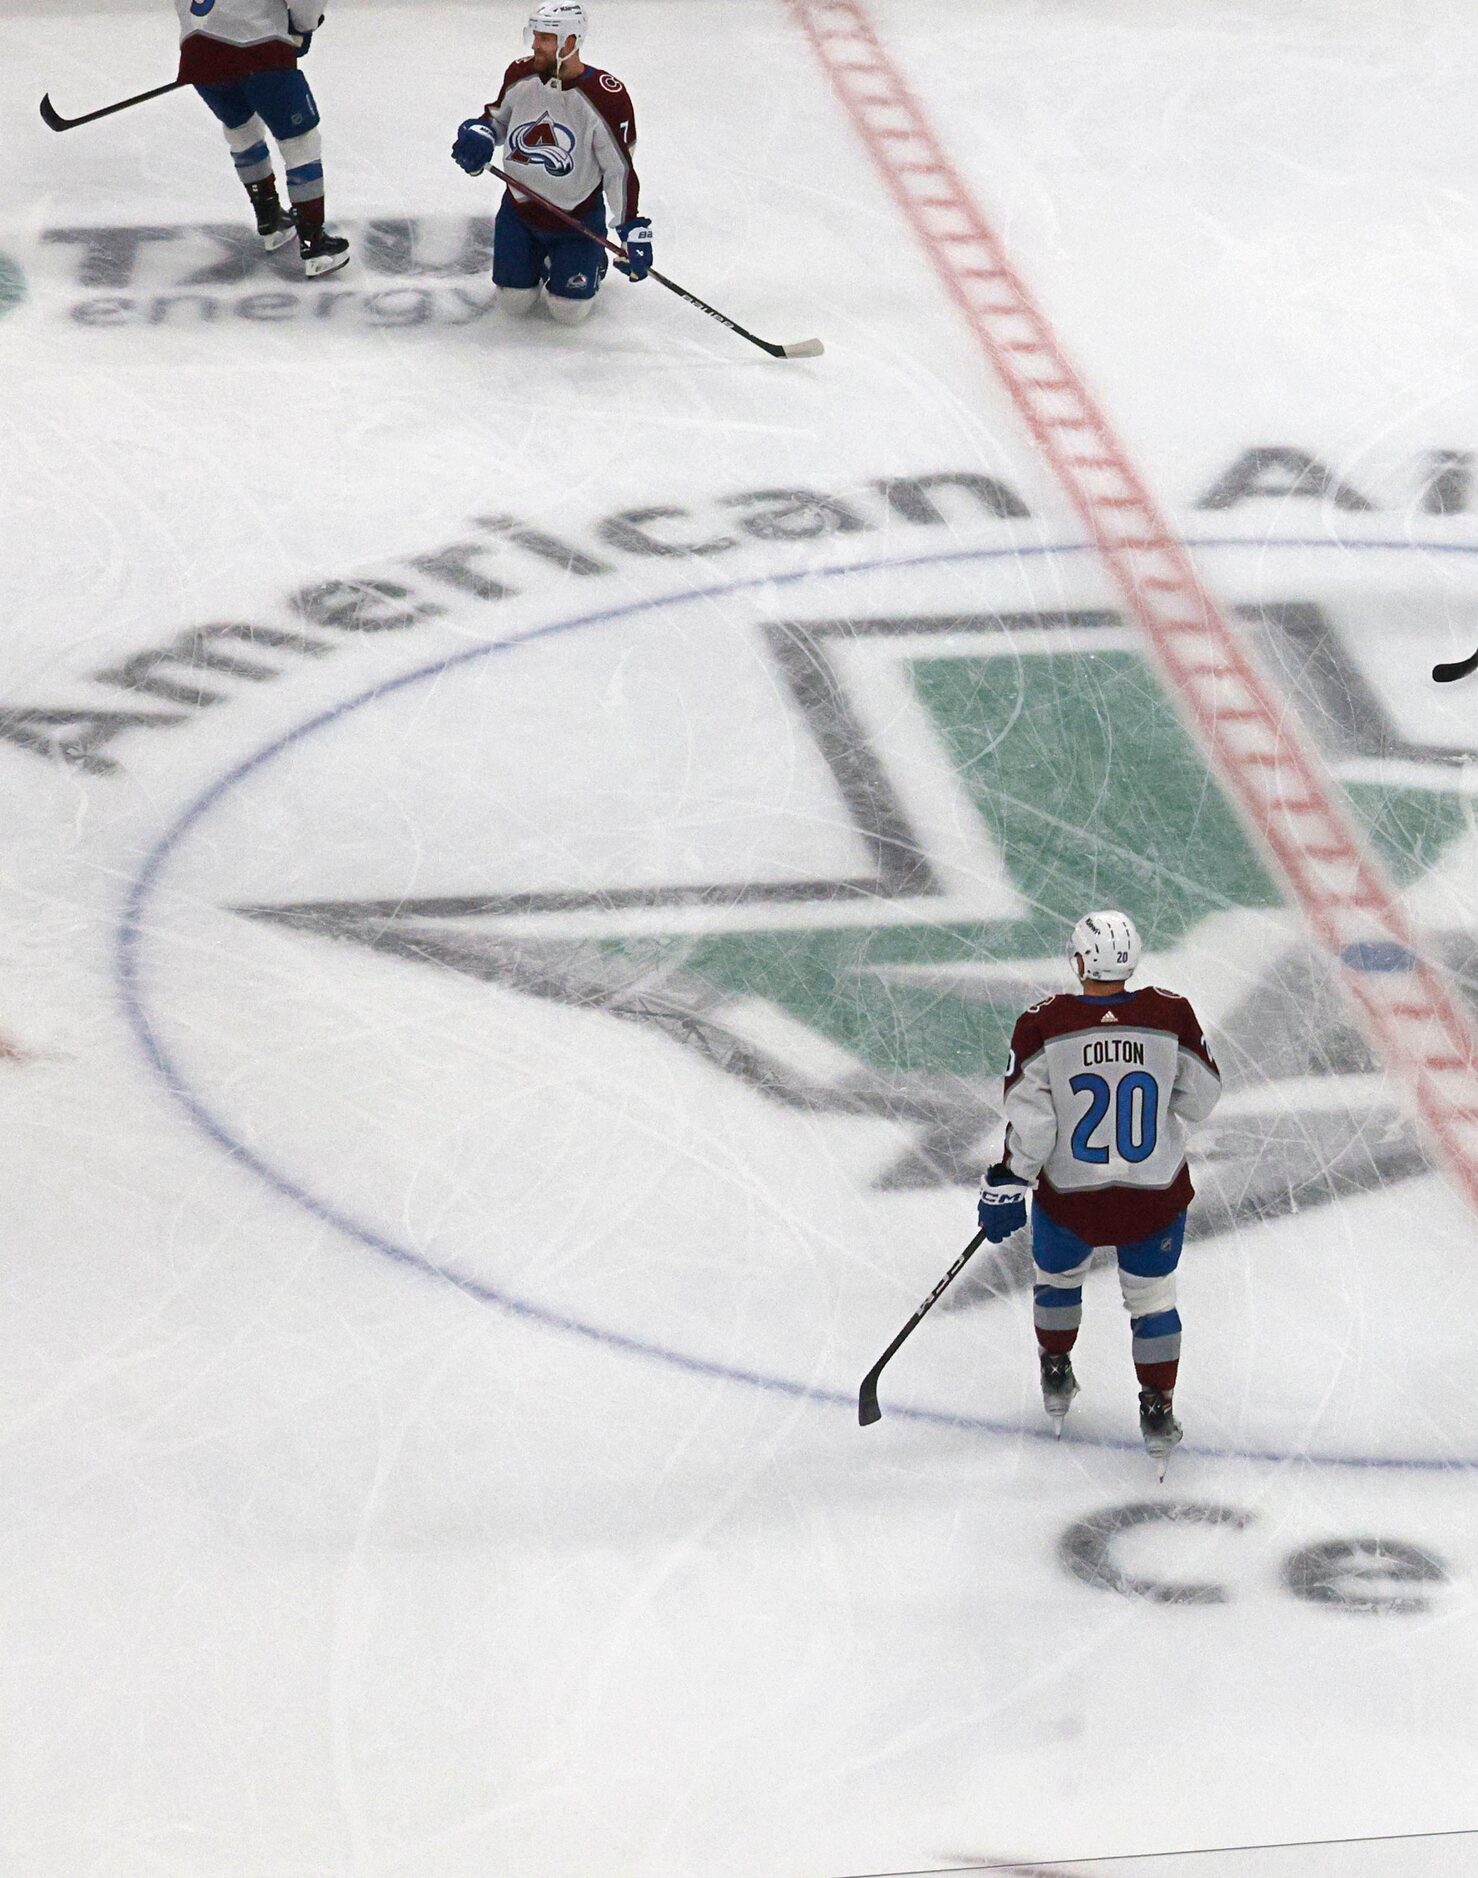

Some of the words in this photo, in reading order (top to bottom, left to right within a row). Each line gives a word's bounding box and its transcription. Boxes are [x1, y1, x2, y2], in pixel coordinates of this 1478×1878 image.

[619, 120, 630, 143] 7
[38, 213, 497, 289] TXU
[68, 286, 498, 328] energy
[0, 472, 1028, 776] American
[1116, 951, 1128, 963] 20
[1083, 1040, 1144, 1067] COLTON
[1069, 1070, 1159, 1164] 20
